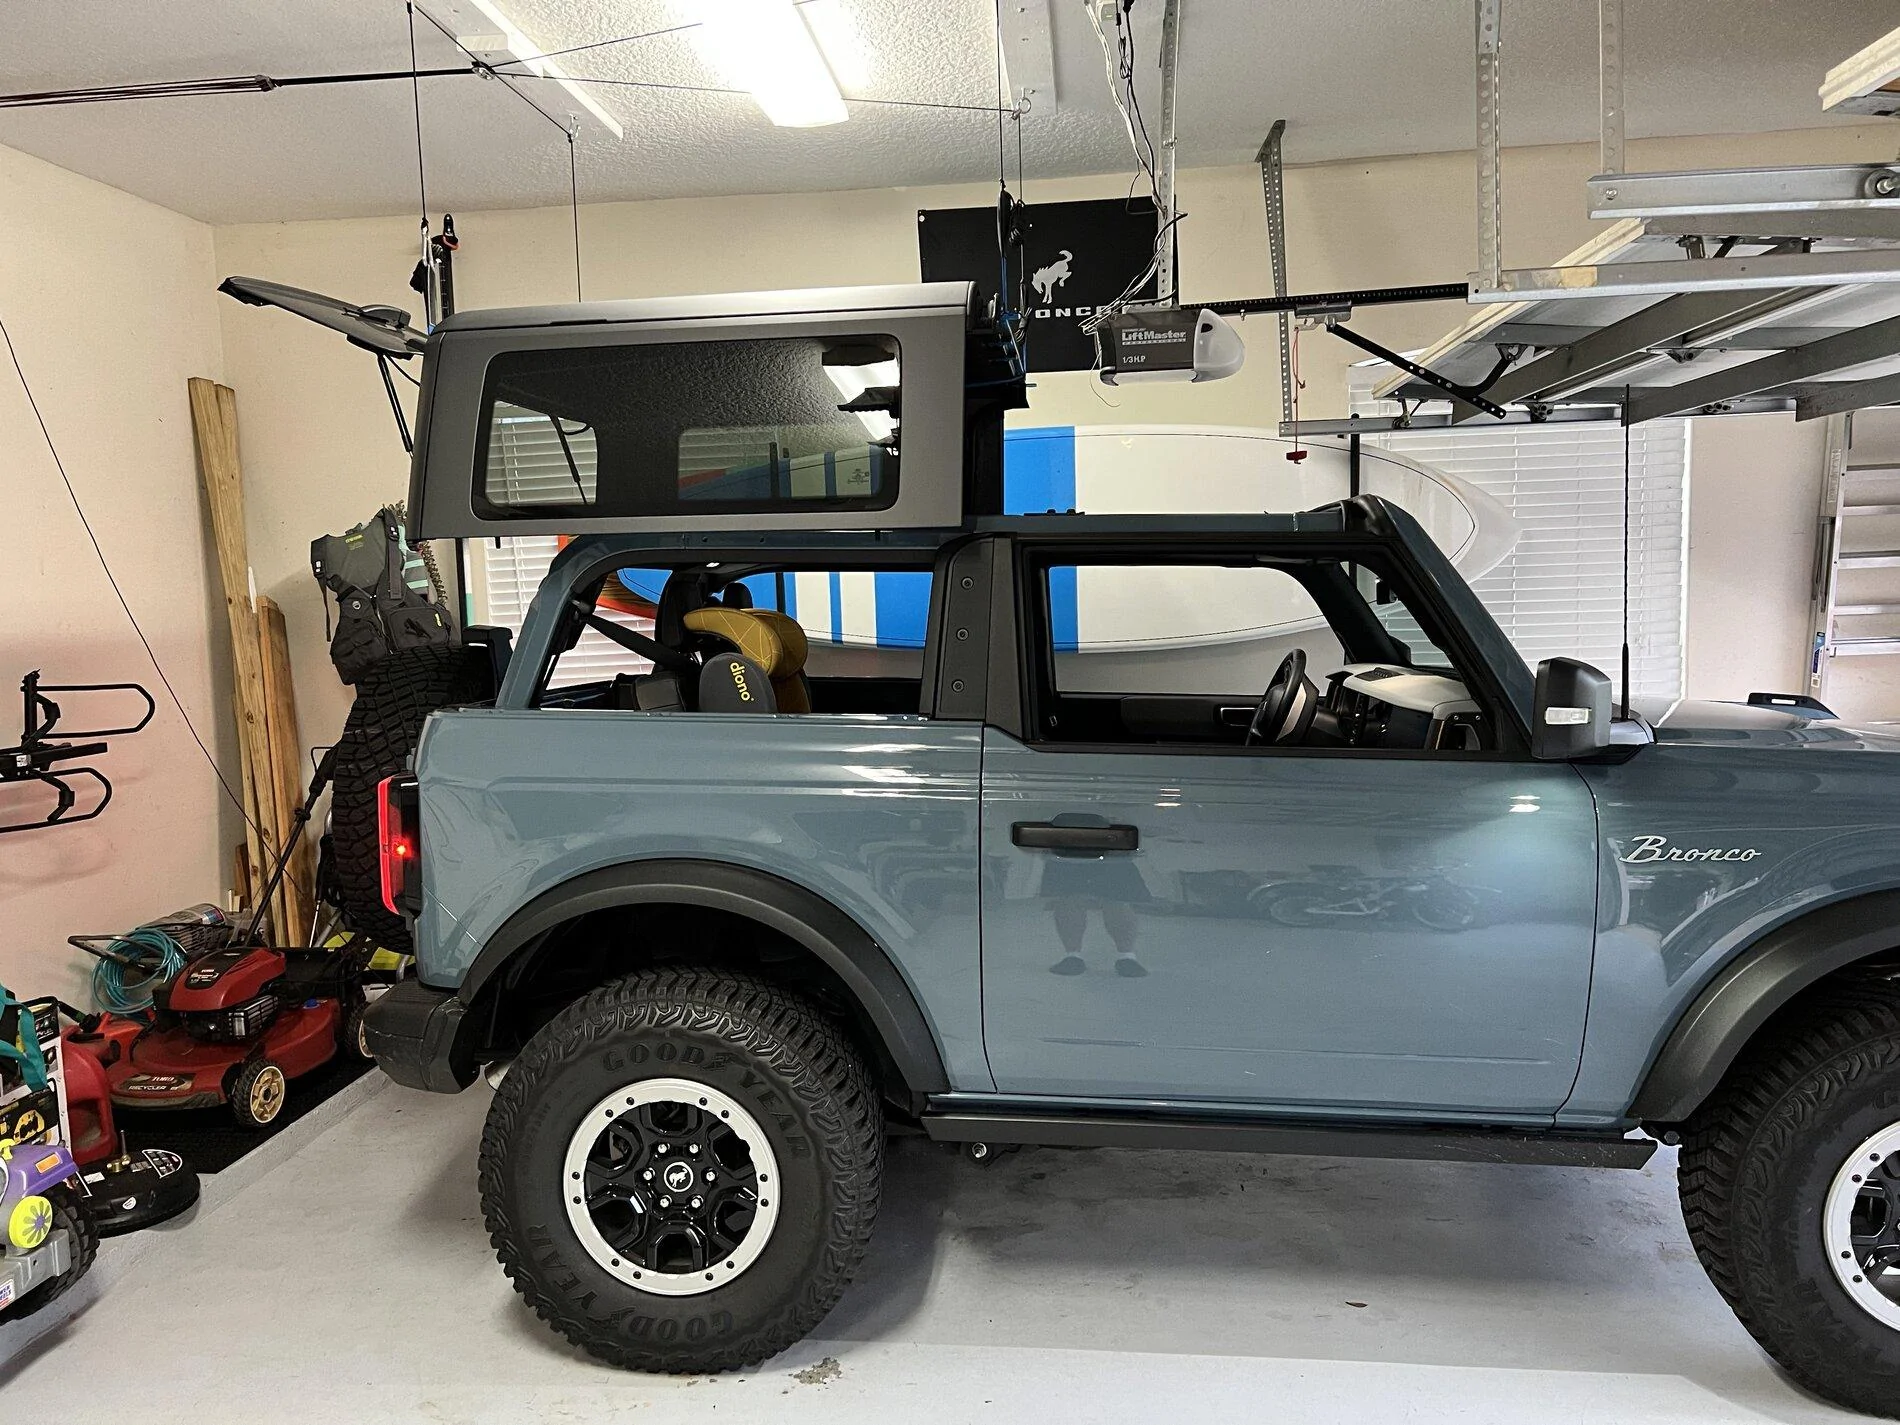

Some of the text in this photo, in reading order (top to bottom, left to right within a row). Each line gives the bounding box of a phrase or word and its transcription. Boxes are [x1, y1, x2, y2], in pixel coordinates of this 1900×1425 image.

[1121, 329, 1187, 341] LiftMaster
[729, 661, 751, 702] diono
[1619, 835, 1762, 863] Bronco
